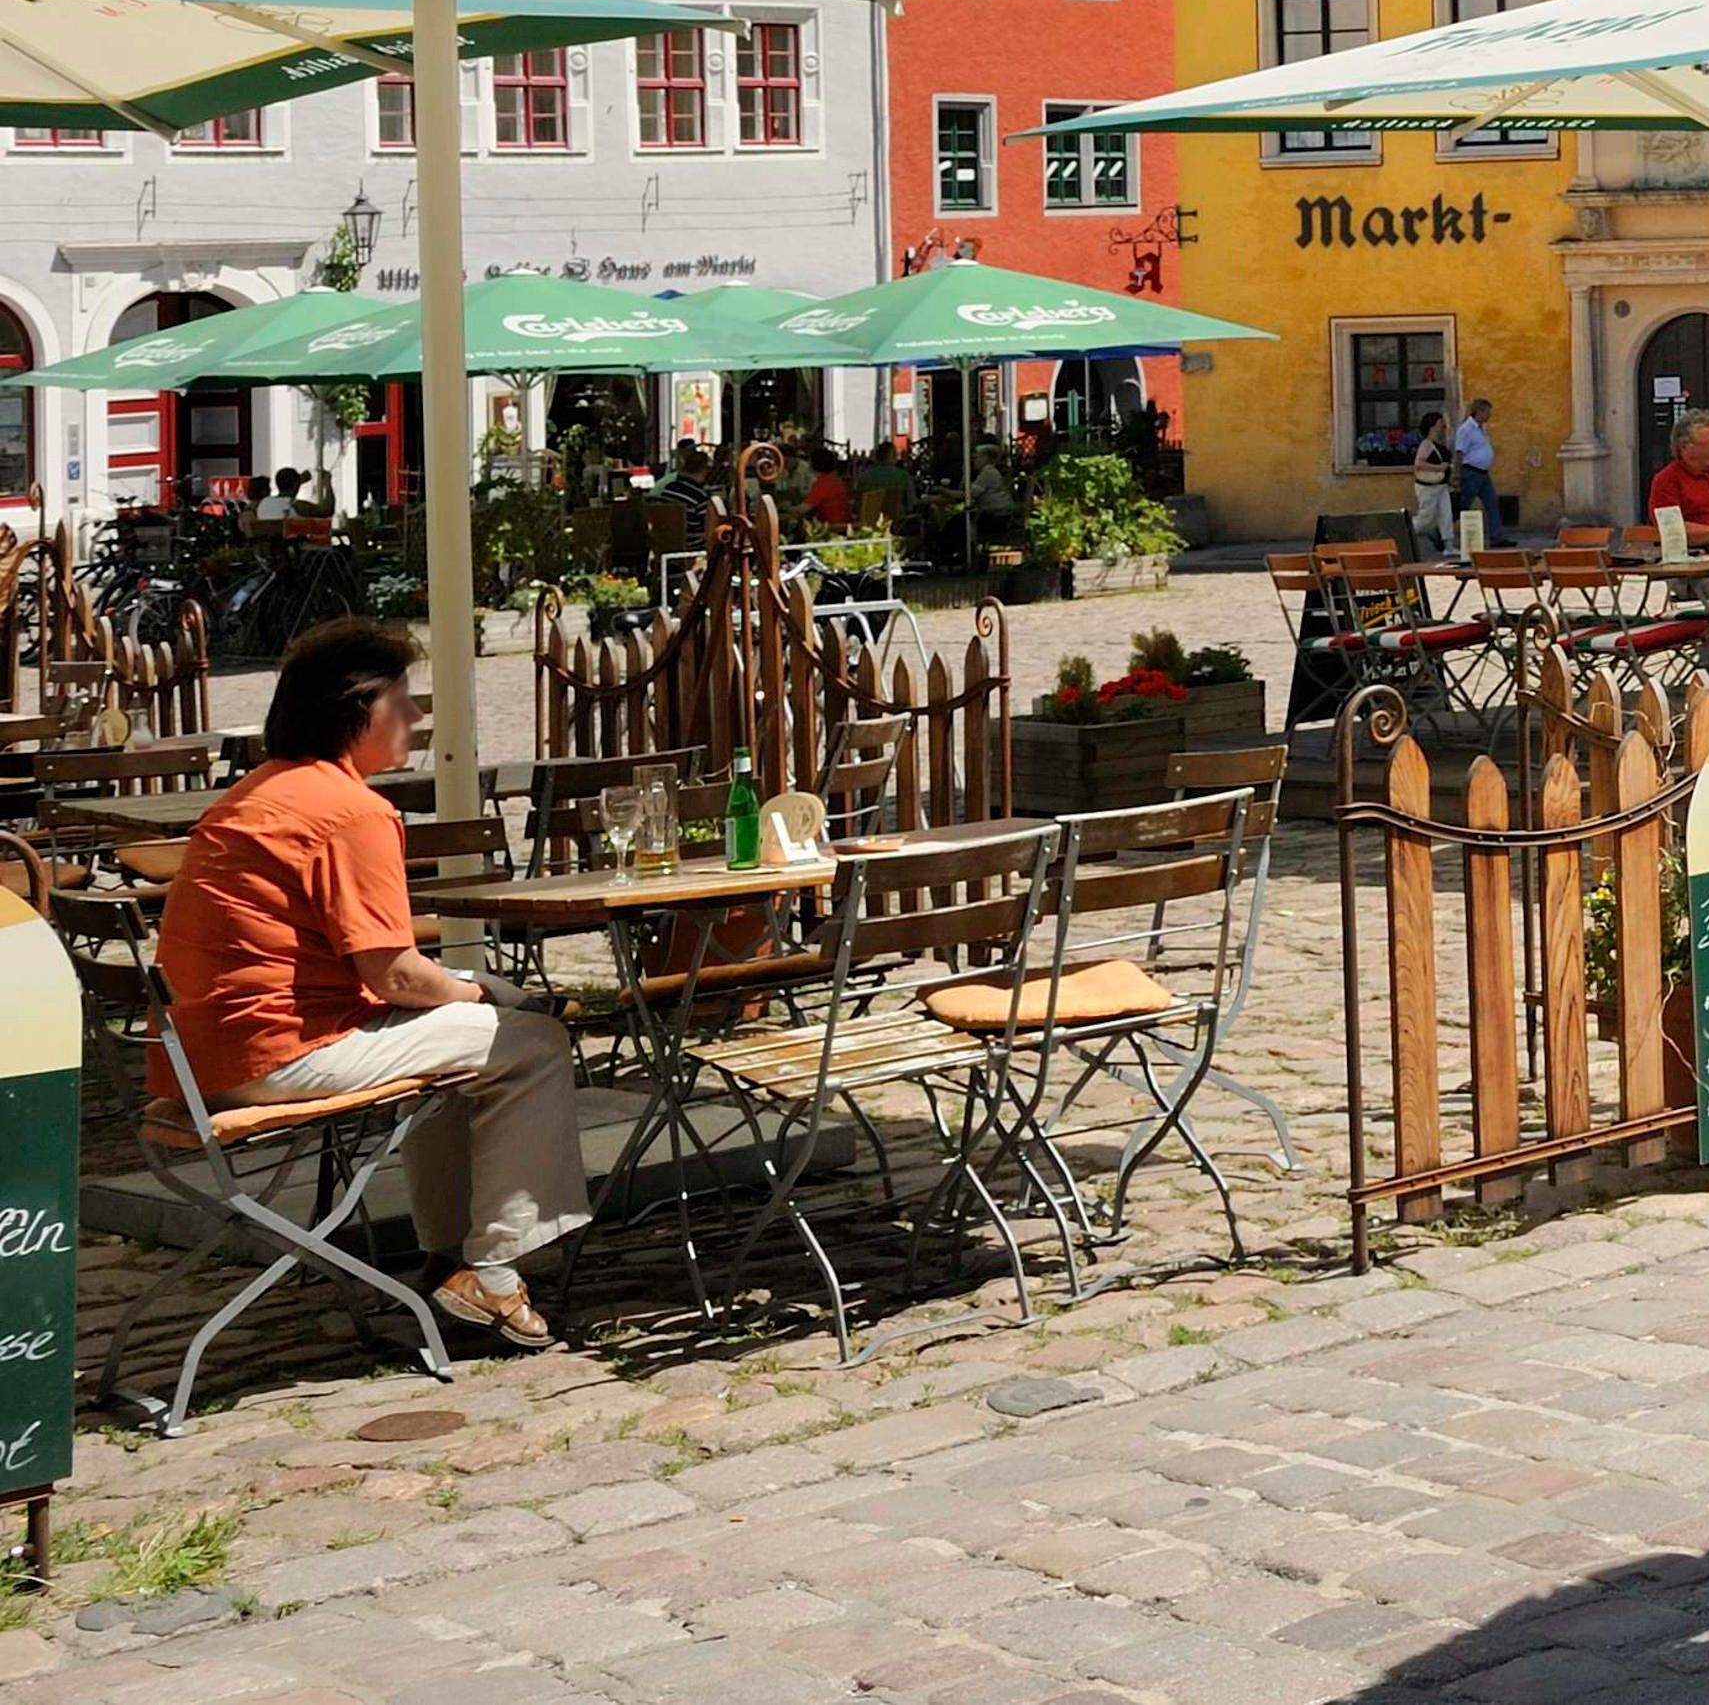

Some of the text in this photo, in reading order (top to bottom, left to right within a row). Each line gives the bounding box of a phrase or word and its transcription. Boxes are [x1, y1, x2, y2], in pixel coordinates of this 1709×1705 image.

[1295, 192, 1512, 249] Markt-
[502, 310, 688, 343] Carlsberg
[957, 299, 1117, 330] Carlsberg
